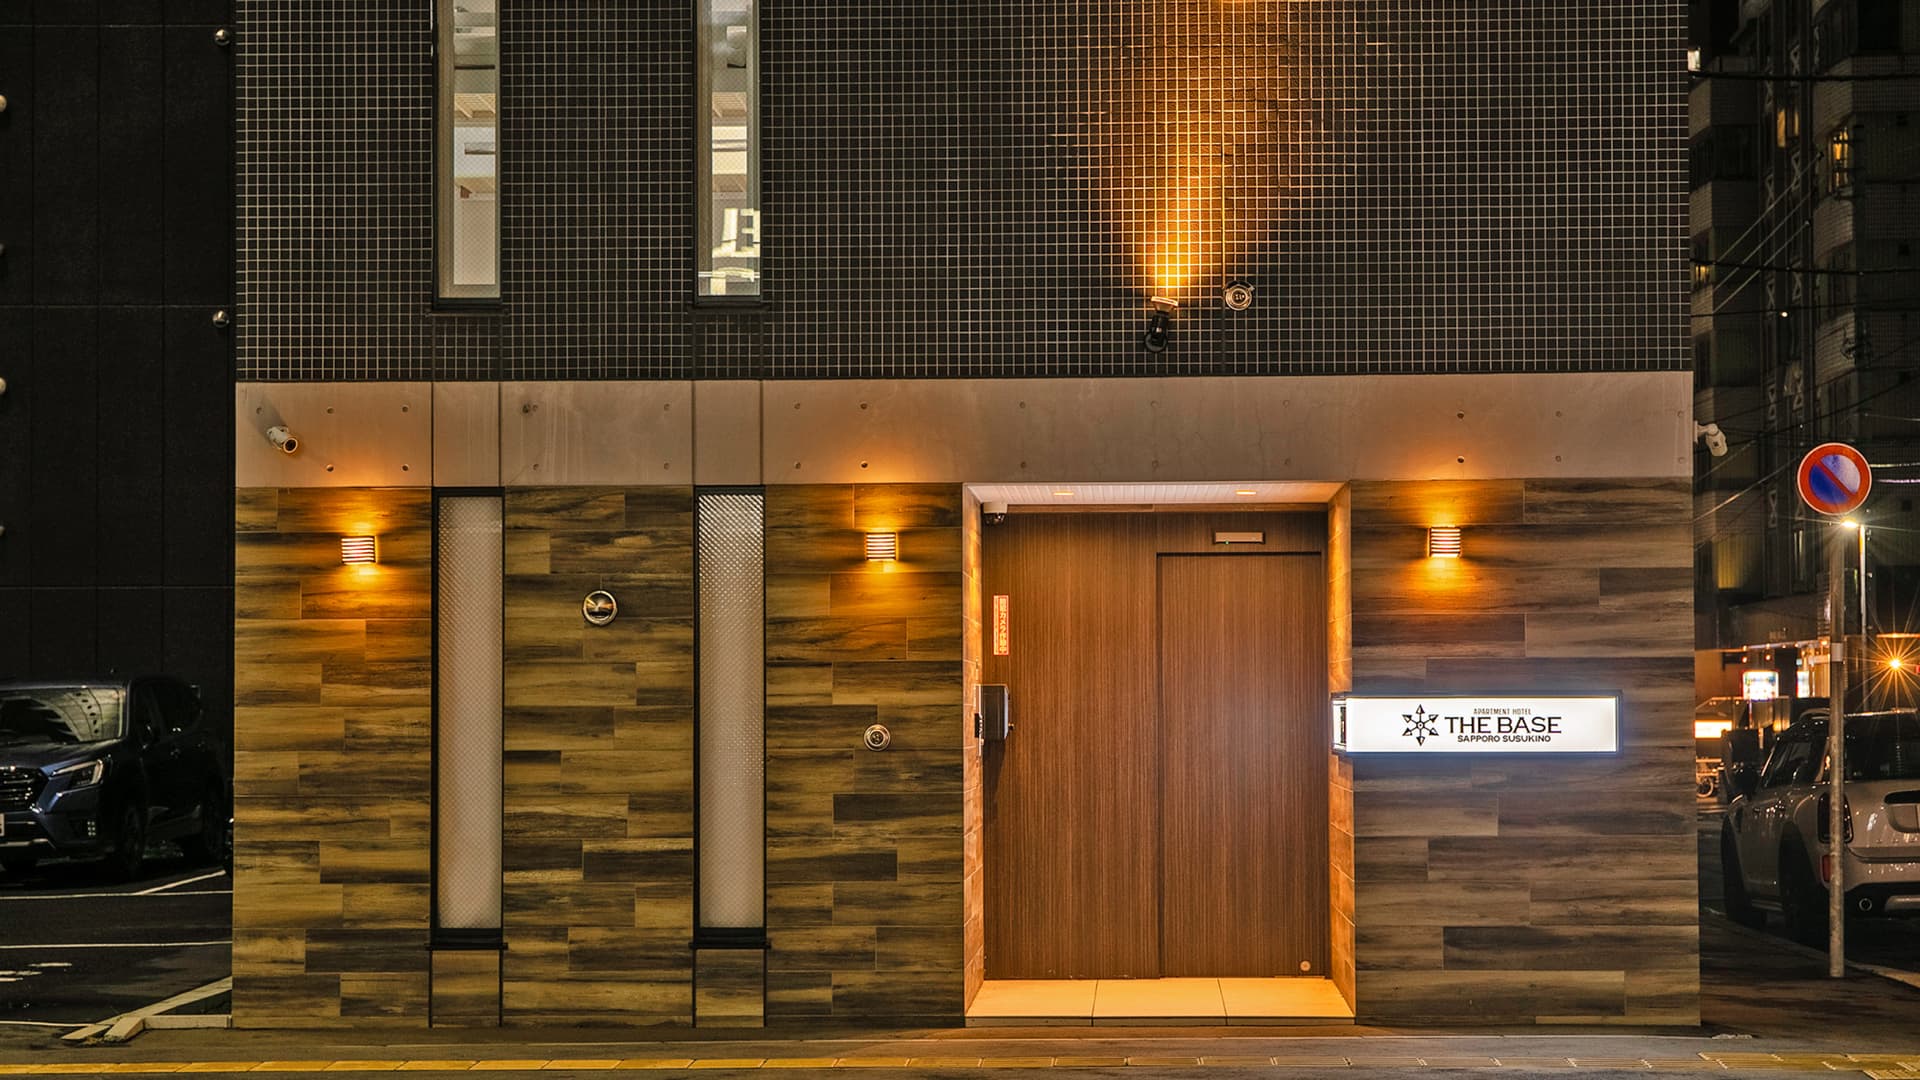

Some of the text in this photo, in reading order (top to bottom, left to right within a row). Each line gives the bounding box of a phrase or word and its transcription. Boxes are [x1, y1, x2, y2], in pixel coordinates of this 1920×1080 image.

[1444, 716, 1562, 734] THE BASE
[1457, 735, 1551, 743] SAPPORO SUSUKINO
